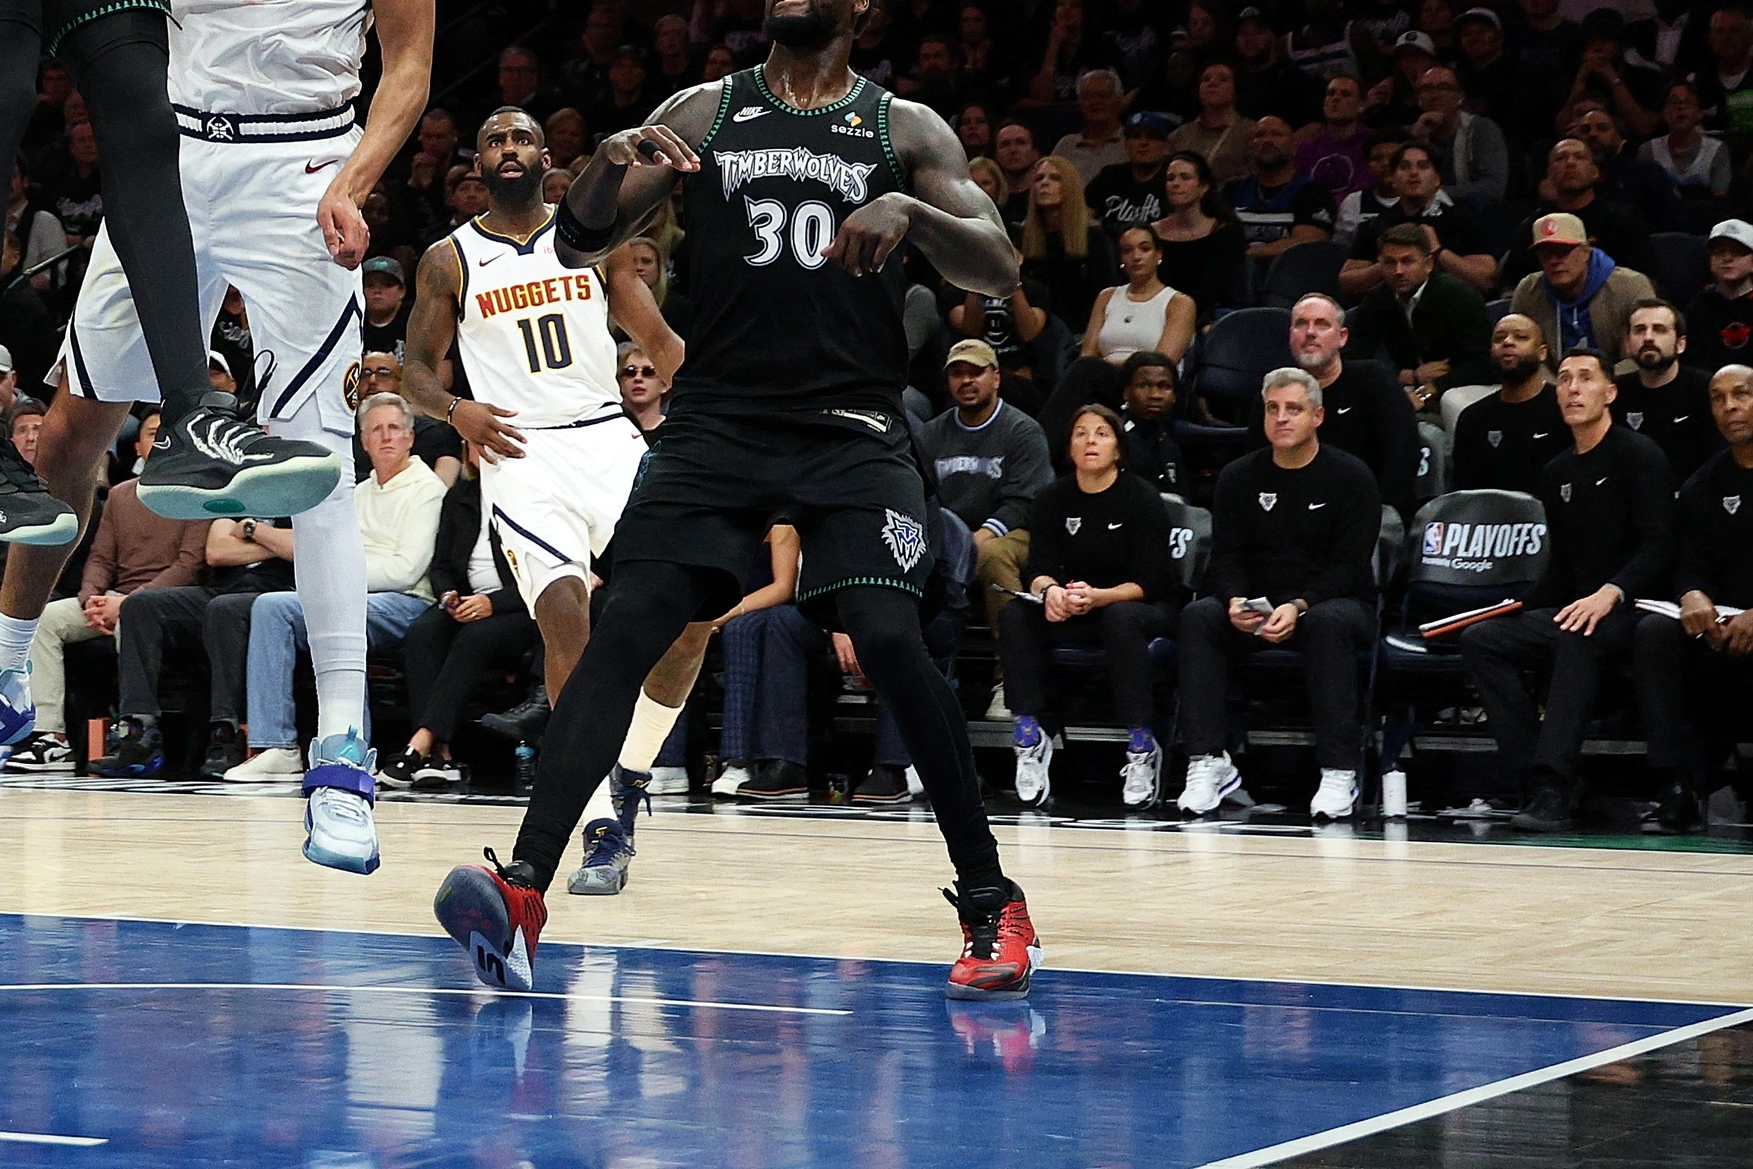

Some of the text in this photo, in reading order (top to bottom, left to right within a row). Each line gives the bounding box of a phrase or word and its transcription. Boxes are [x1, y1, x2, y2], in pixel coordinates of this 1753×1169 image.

[739, 106, 764, 116] NIKE
[830, 124, 875, 139] sezzle
[713, 146, 878, 204] TIMBERWOLVES
[743, 194, 836, 270] 30
[475, 274, 592, 320] NUGGETS
[516, 313, 574, 374] 10
[1442, 523, 1547, 557] PLAYOFFS
[1450, 558, 1493, 572] Google
